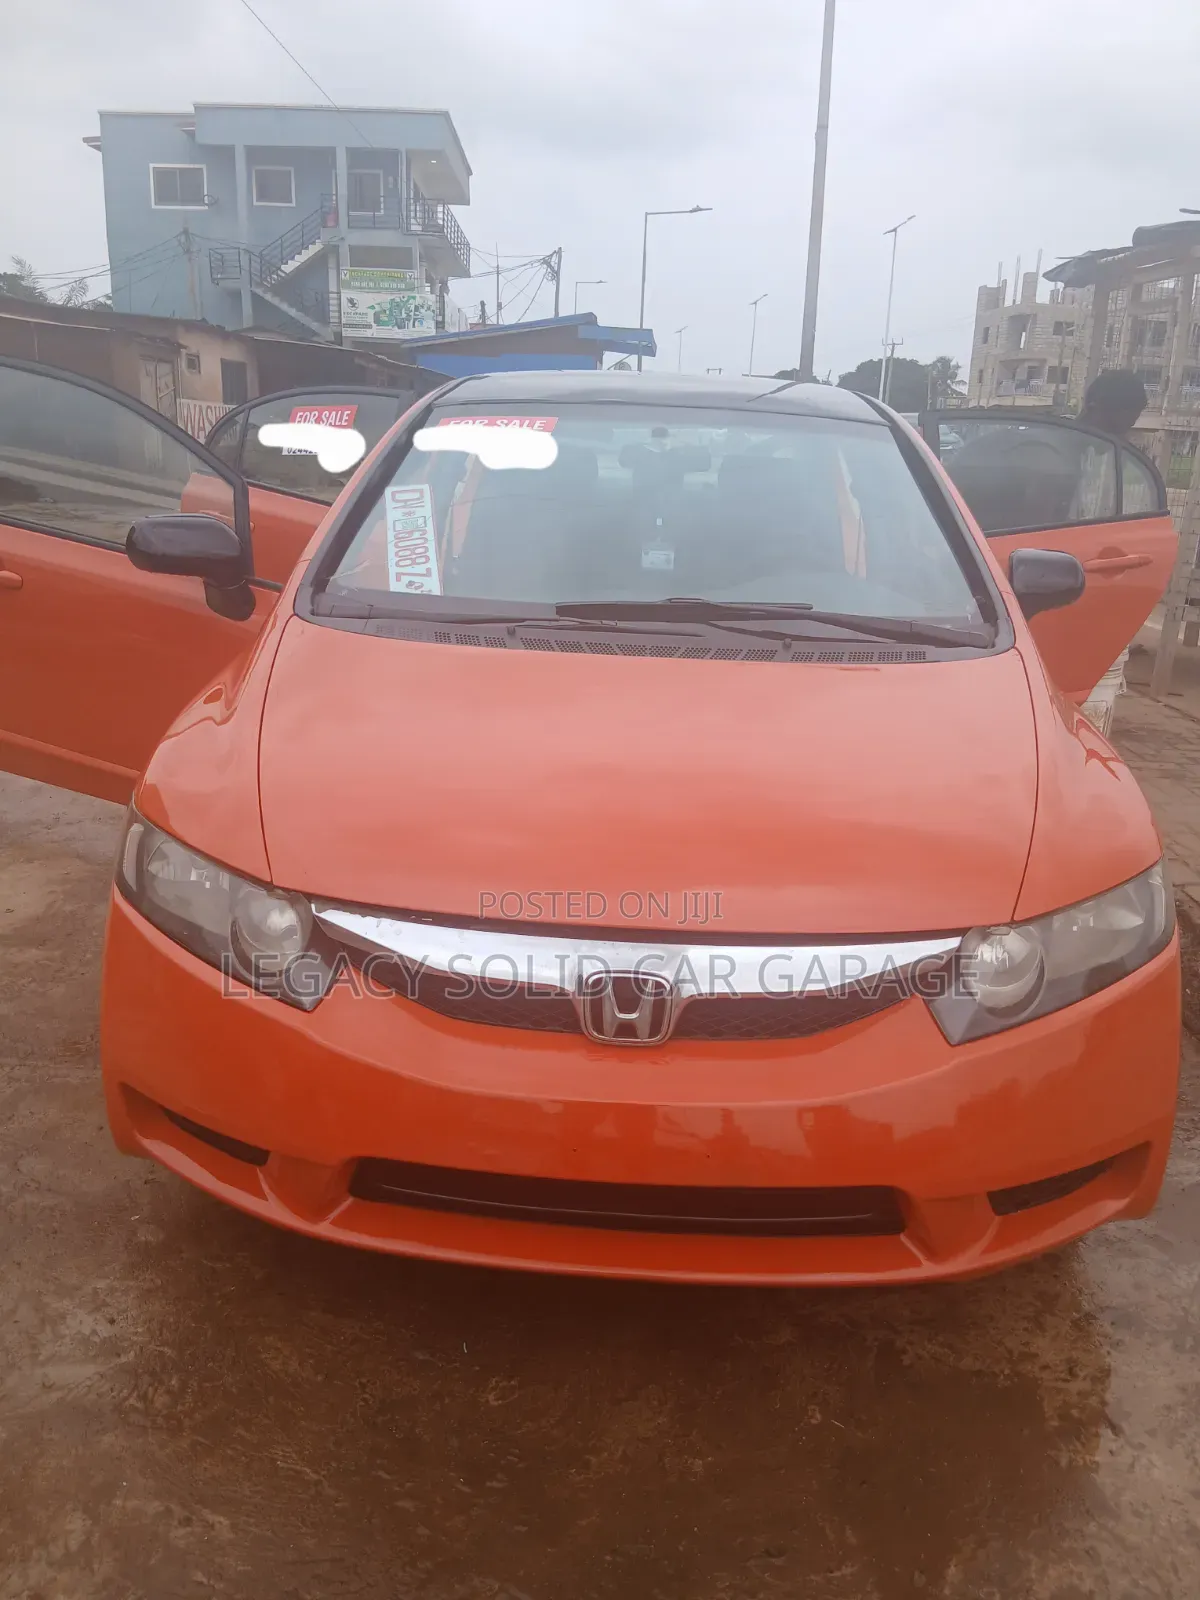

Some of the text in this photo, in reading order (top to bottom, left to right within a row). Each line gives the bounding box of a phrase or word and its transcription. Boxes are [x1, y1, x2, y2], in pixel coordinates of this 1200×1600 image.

[295, 410, 351, 426] FOR SALE
[494, 419, 547, 430] SALE
[393, 529, 430, 568] 6088
[395, 567, 432, 583] Z
